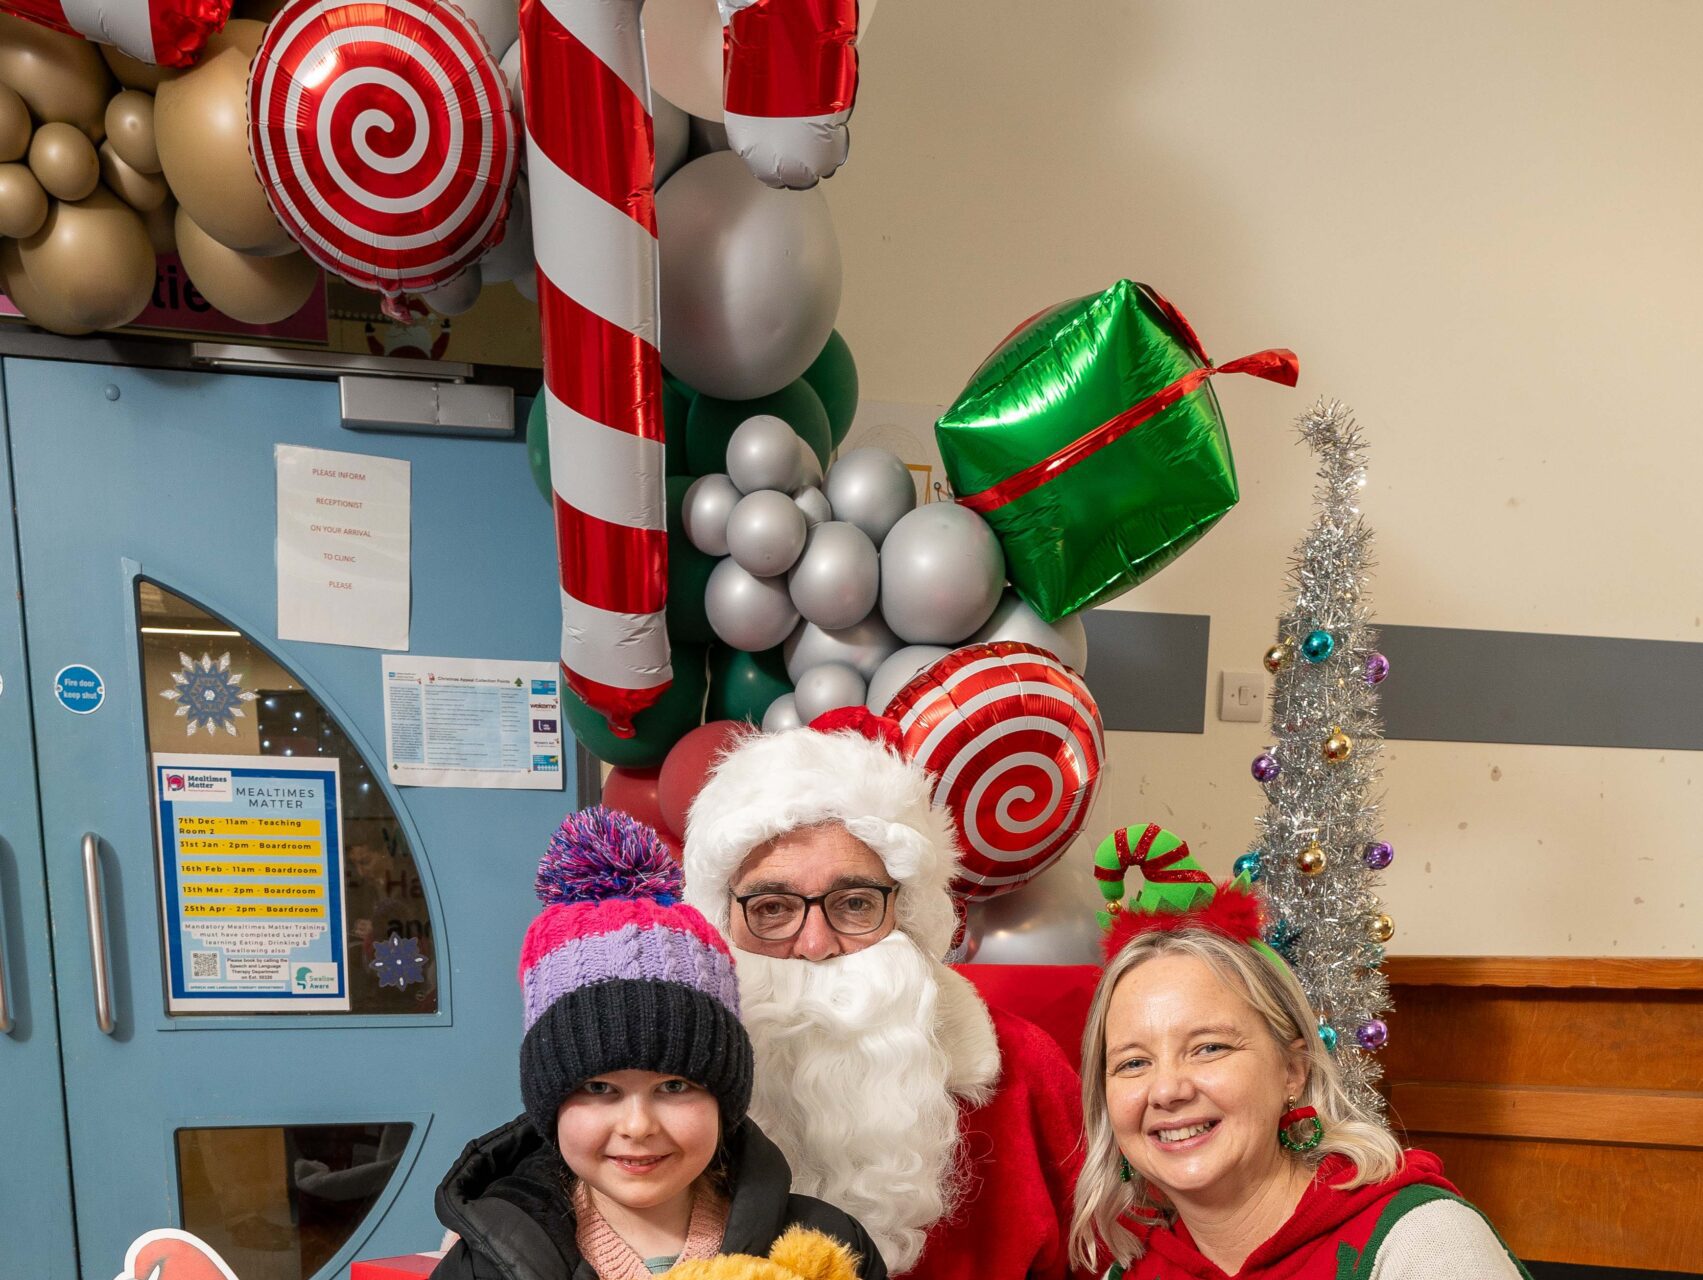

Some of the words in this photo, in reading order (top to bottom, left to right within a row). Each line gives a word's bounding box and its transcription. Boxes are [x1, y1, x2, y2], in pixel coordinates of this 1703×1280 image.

[312, 468, 336, 477] PLEASE
[338, 472, 366, 480] INFORM
[316, 497, 363, 509] RECEPTIONIST
[344, 528, 371, 537] ARRIVAL
[334, 554, 356, 562] CLINIC
[329, 581, 352, 590] PLEASE
[63, 690, 80, 700] keep
[236, 788, 315, 798] MEALTIMES
[248, 799, 303, 809] MATTER
[259, 819, 302, 827] Teaching
[229, 842, 249, 850] 2pm
